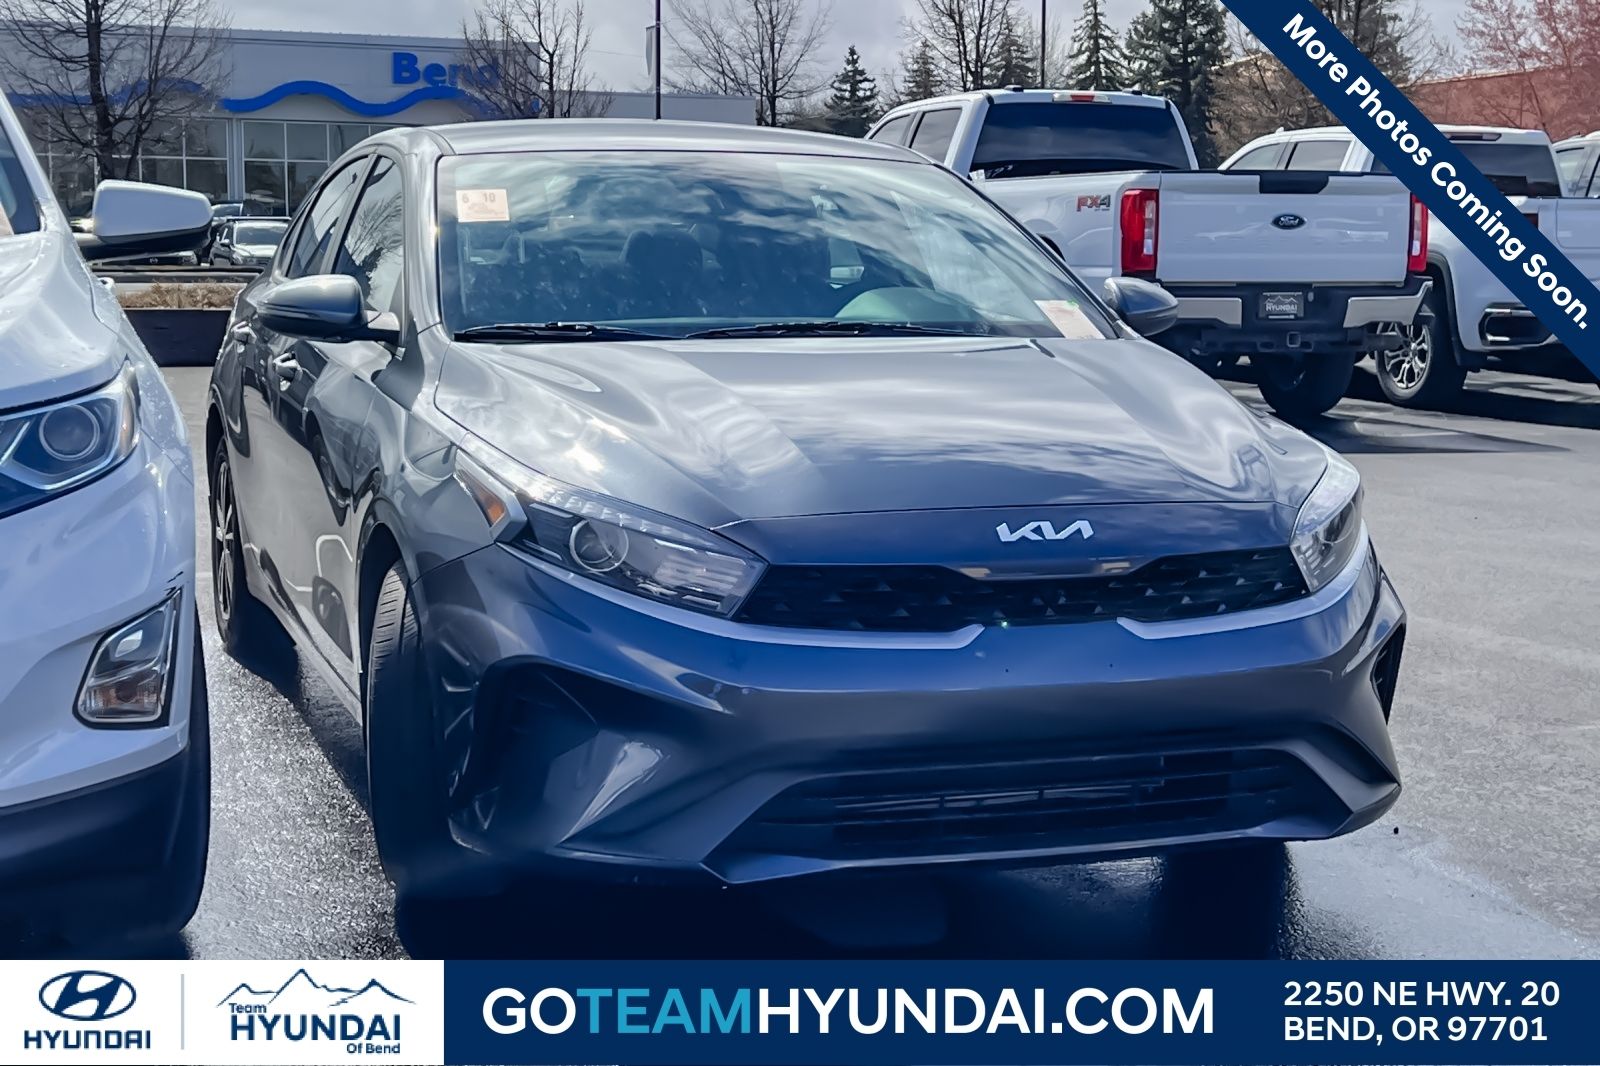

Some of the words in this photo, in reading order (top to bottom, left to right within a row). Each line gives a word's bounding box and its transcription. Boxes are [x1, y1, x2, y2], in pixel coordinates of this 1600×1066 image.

[1076, 194, 1111, 212] FX4
[1278, 215, 1300, 226] Ford
[1265, 303, 1298, 312] HYUNDAI
